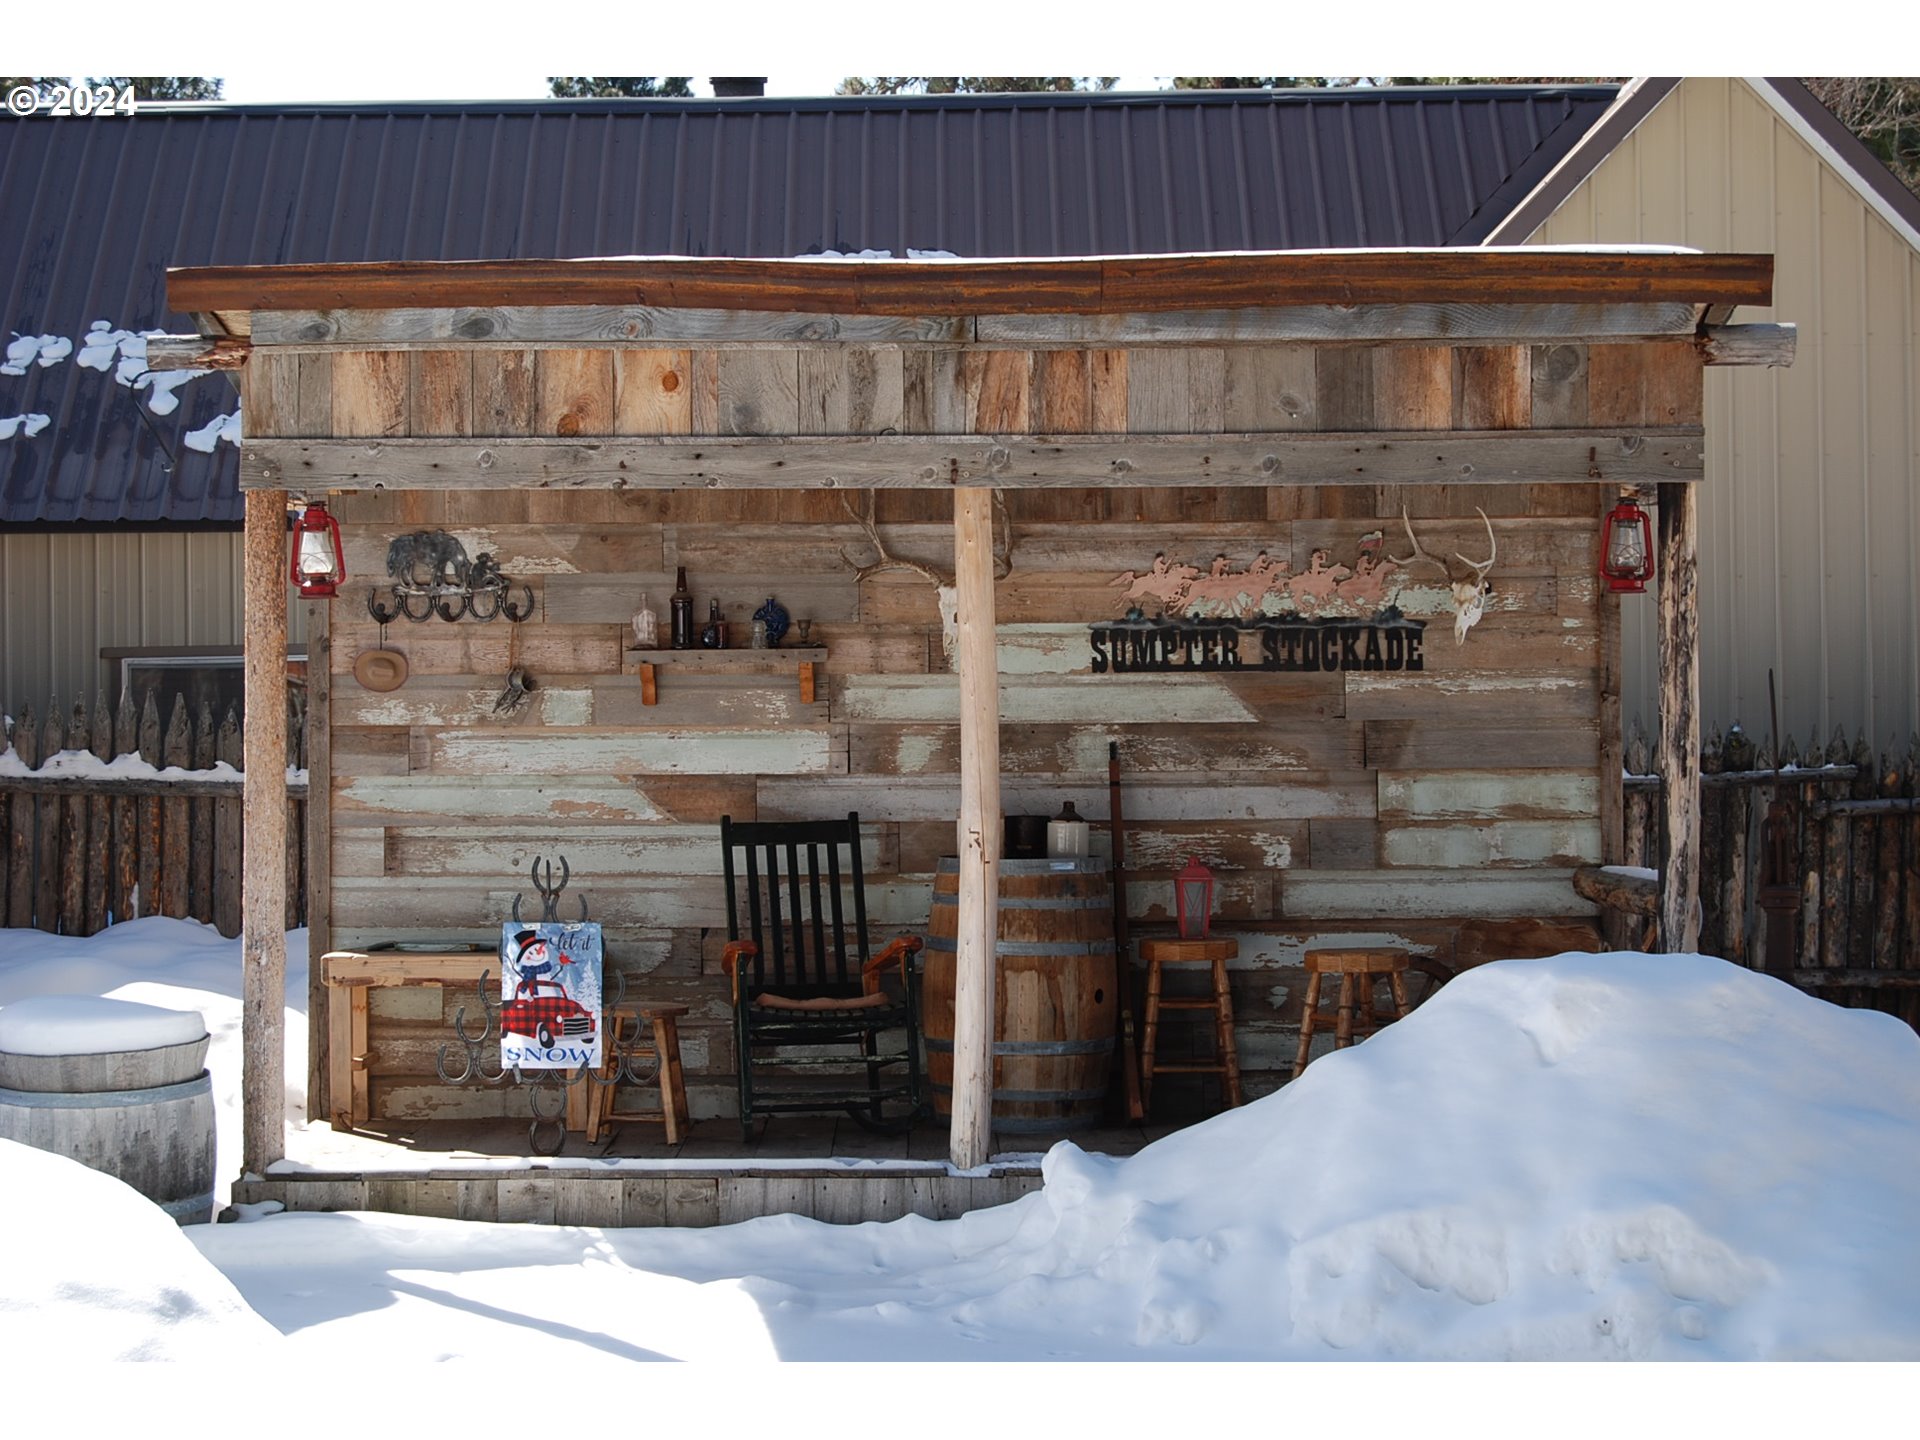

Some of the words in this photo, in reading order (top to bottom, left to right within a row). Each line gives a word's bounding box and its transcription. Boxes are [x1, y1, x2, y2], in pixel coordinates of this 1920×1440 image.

[1091, 628, 1243, 673] SUMPTER
[1261, 627, 1425, 672] STOCKADE
[506, 1047, 596, 1063] SNOW
